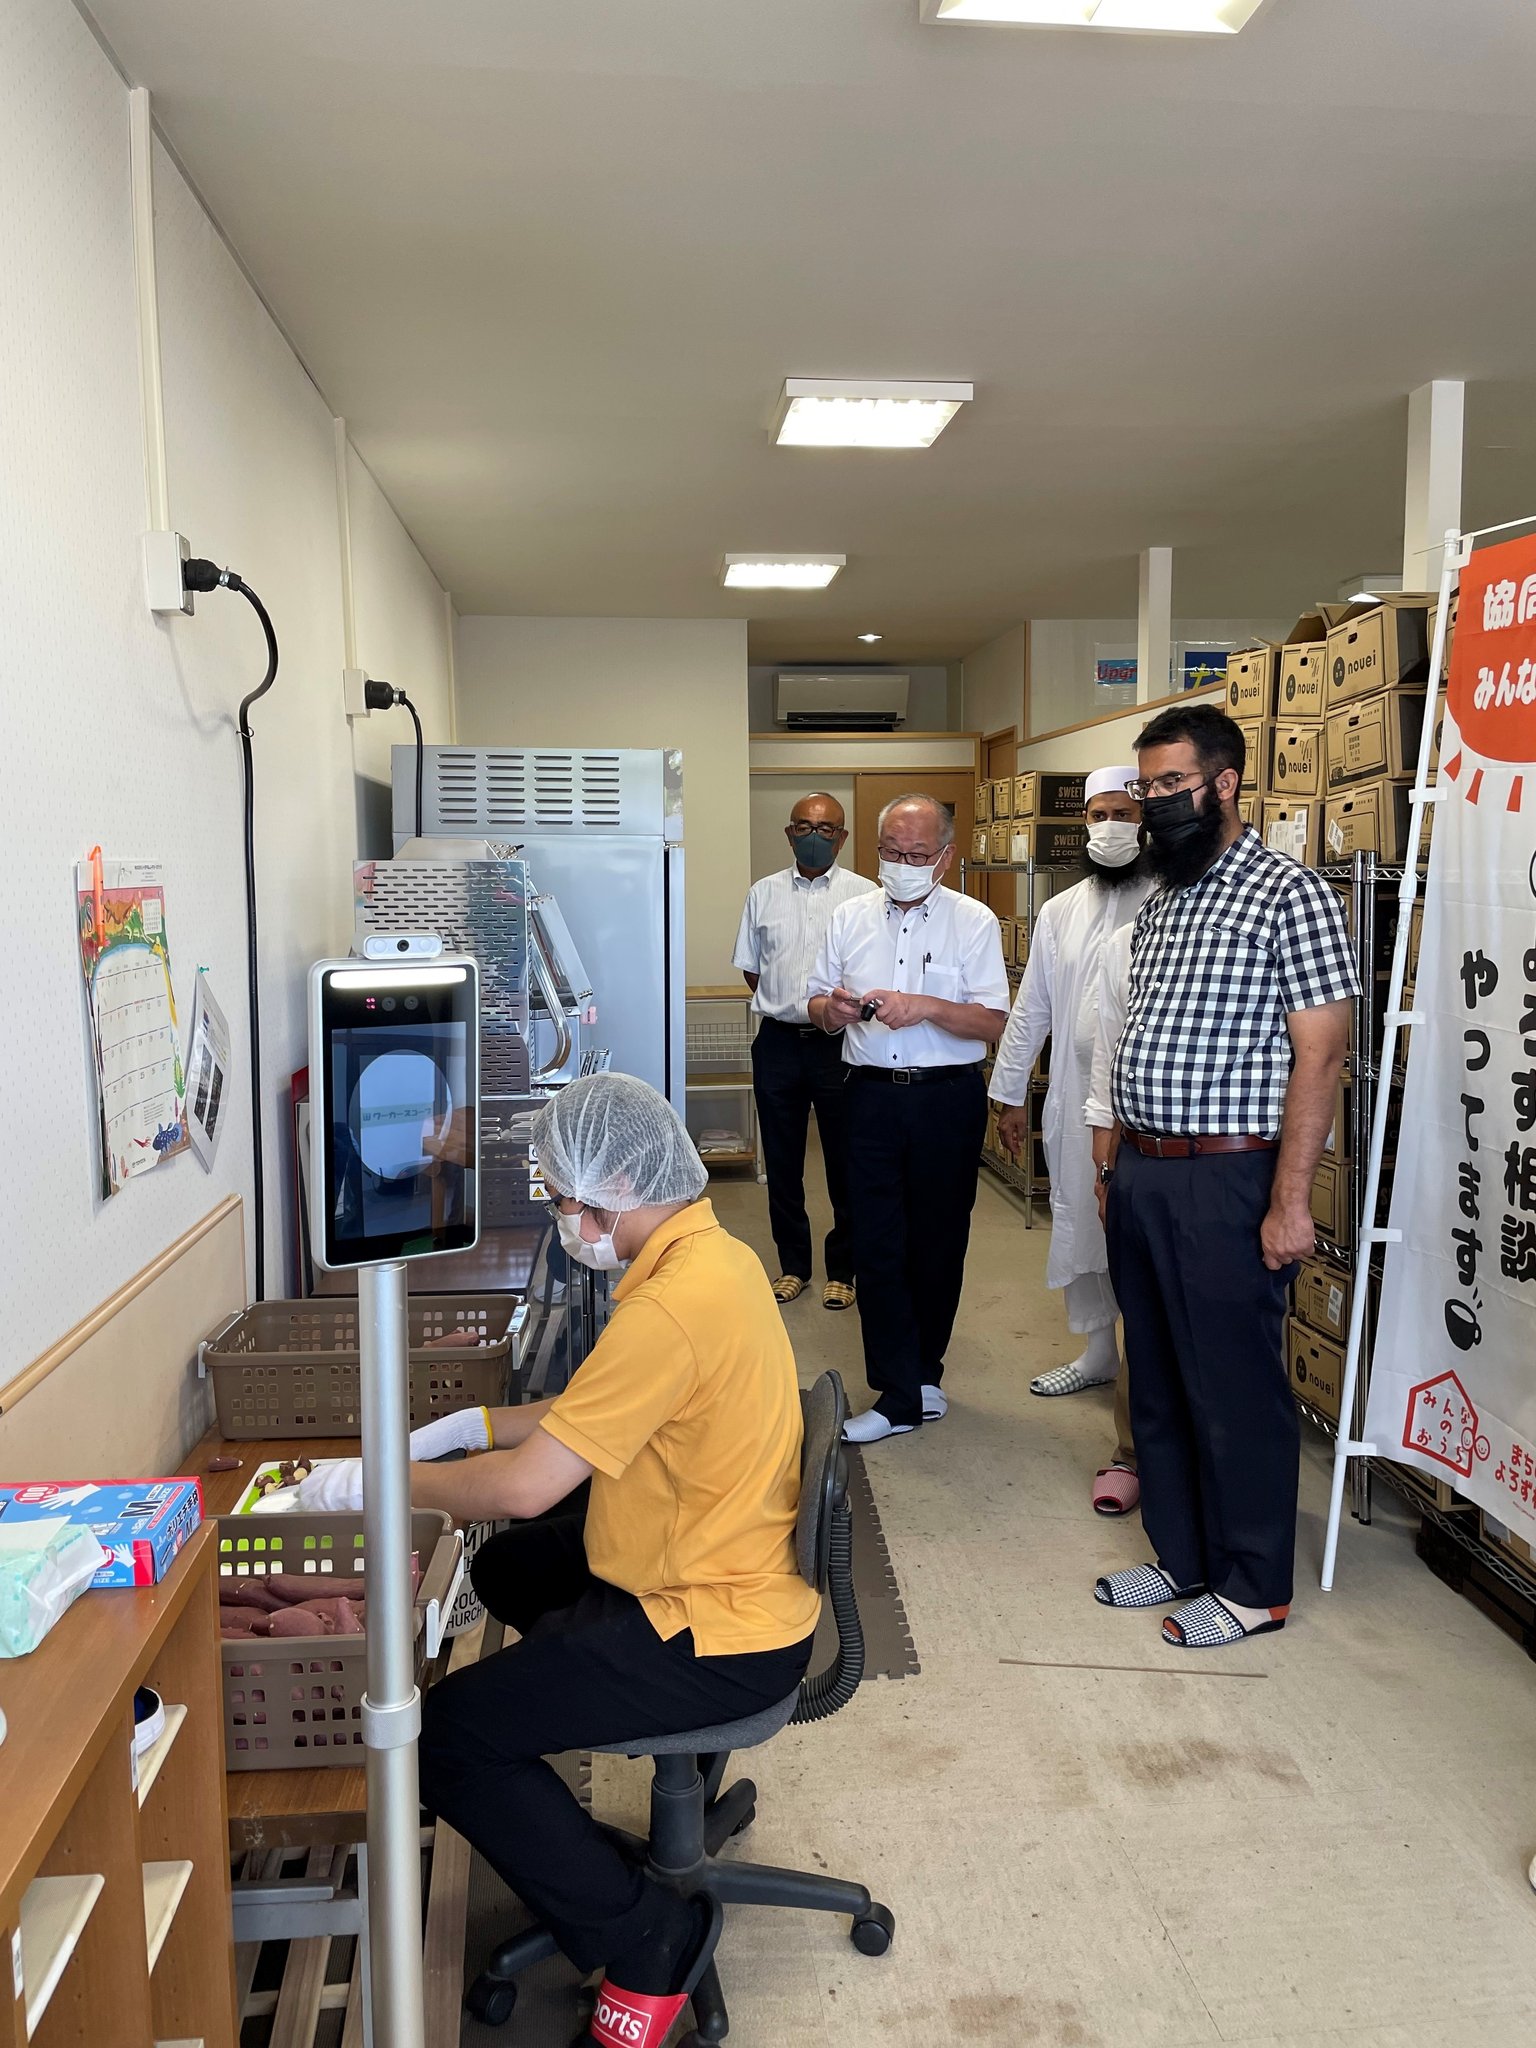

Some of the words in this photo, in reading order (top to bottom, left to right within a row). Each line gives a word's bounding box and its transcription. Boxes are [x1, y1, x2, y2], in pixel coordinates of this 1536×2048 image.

[1347, 649, 1376, 676] nouei
[1240, 683, 1260, 698] nouei
[1297, 680, 1319, 695] nouei
[1288, 759, 1312, 774] nouei
[1058, 786, 1083, 799] SWEET
[1054, 834, 1079, 846] SWEET
[1309, 1371, 1335, 1398] nouei
[1422, 1390, 1471, 1425] みんな
[1440, 1419, 1453, 1434] の
[1416, 1427, 1464, 1464] おうち
